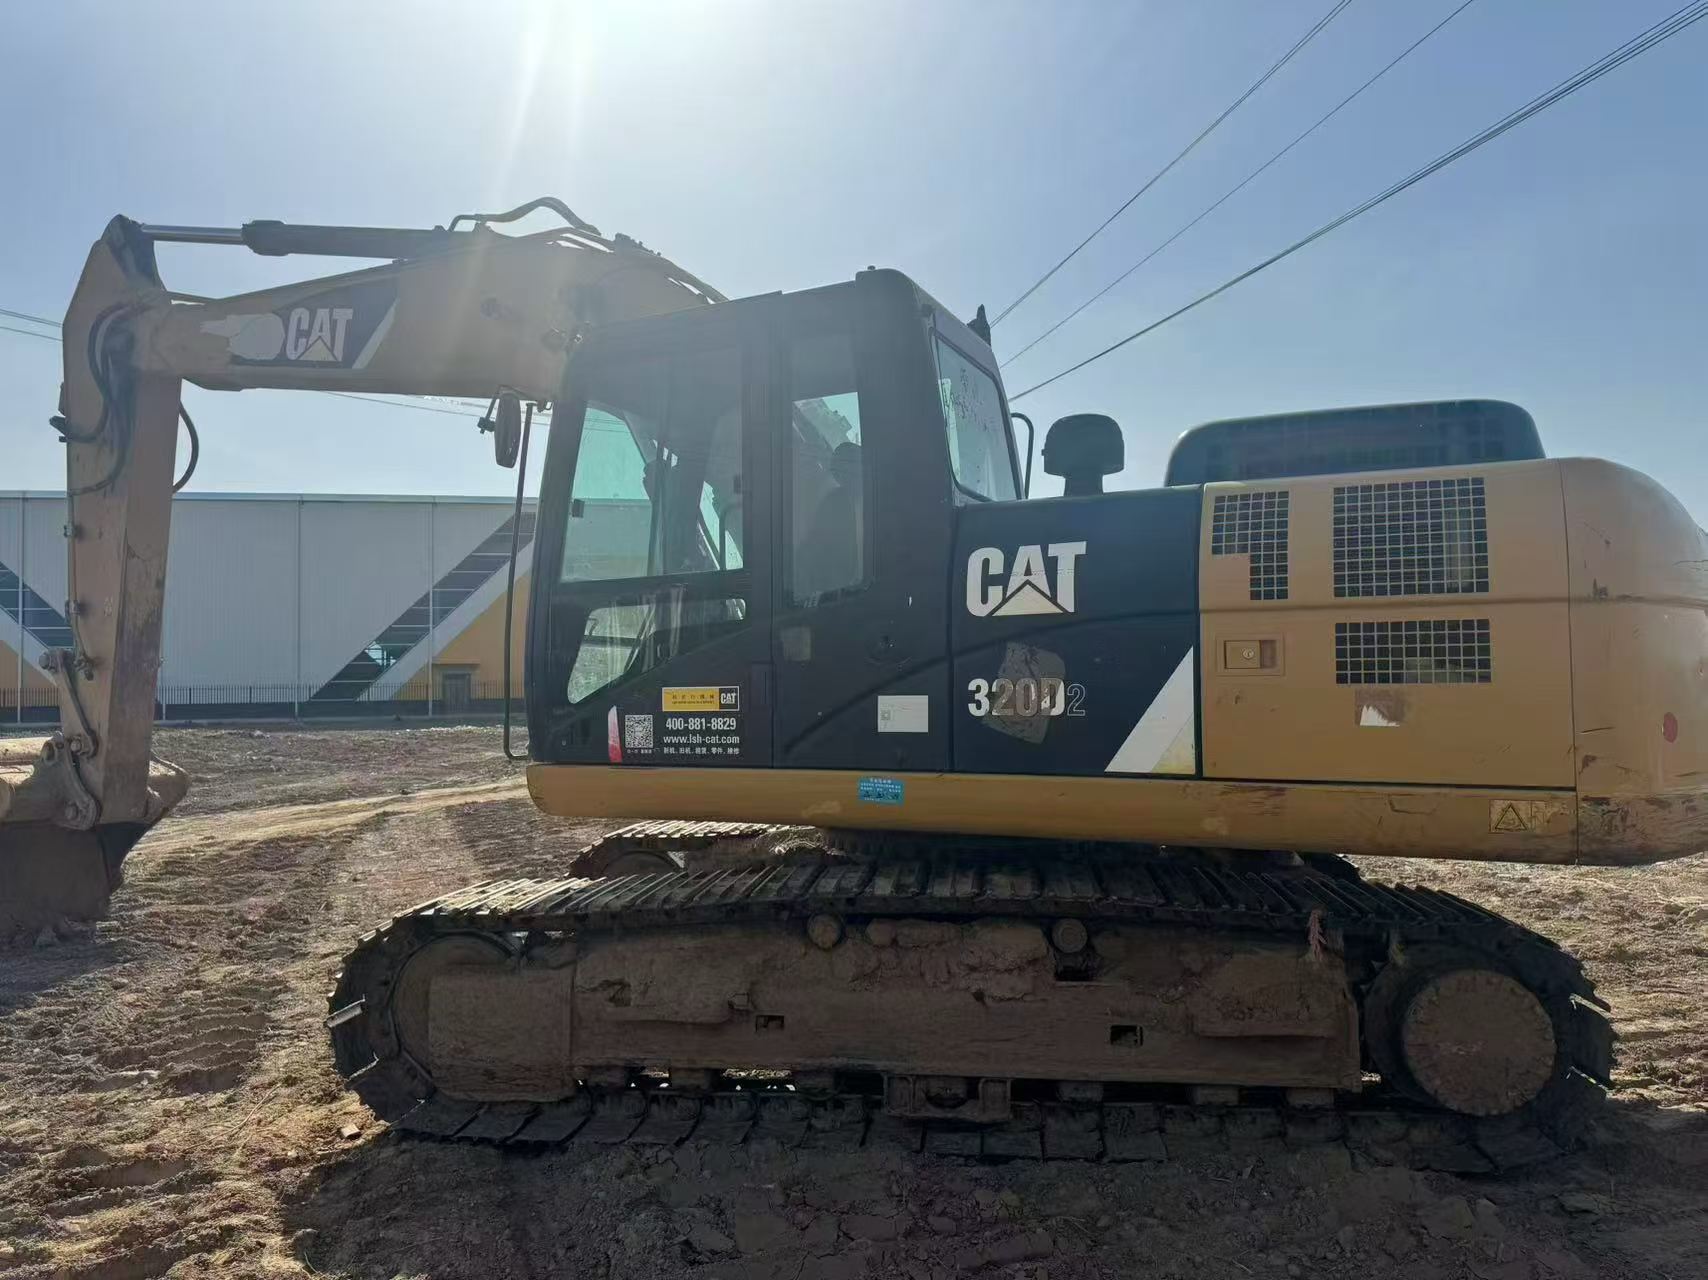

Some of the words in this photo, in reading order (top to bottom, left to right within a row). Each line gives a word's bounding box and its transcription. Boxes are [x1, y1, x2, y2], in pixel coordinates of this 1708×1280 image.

[286, 308, 354, 362] CAT
[966, 541, 1088, 617] CAT
[720, 692, 737, 704] CAT
[665, 717, 737, 731] 400-881-8829
[663, 733, 740, 744] www.lsh-cat.com
